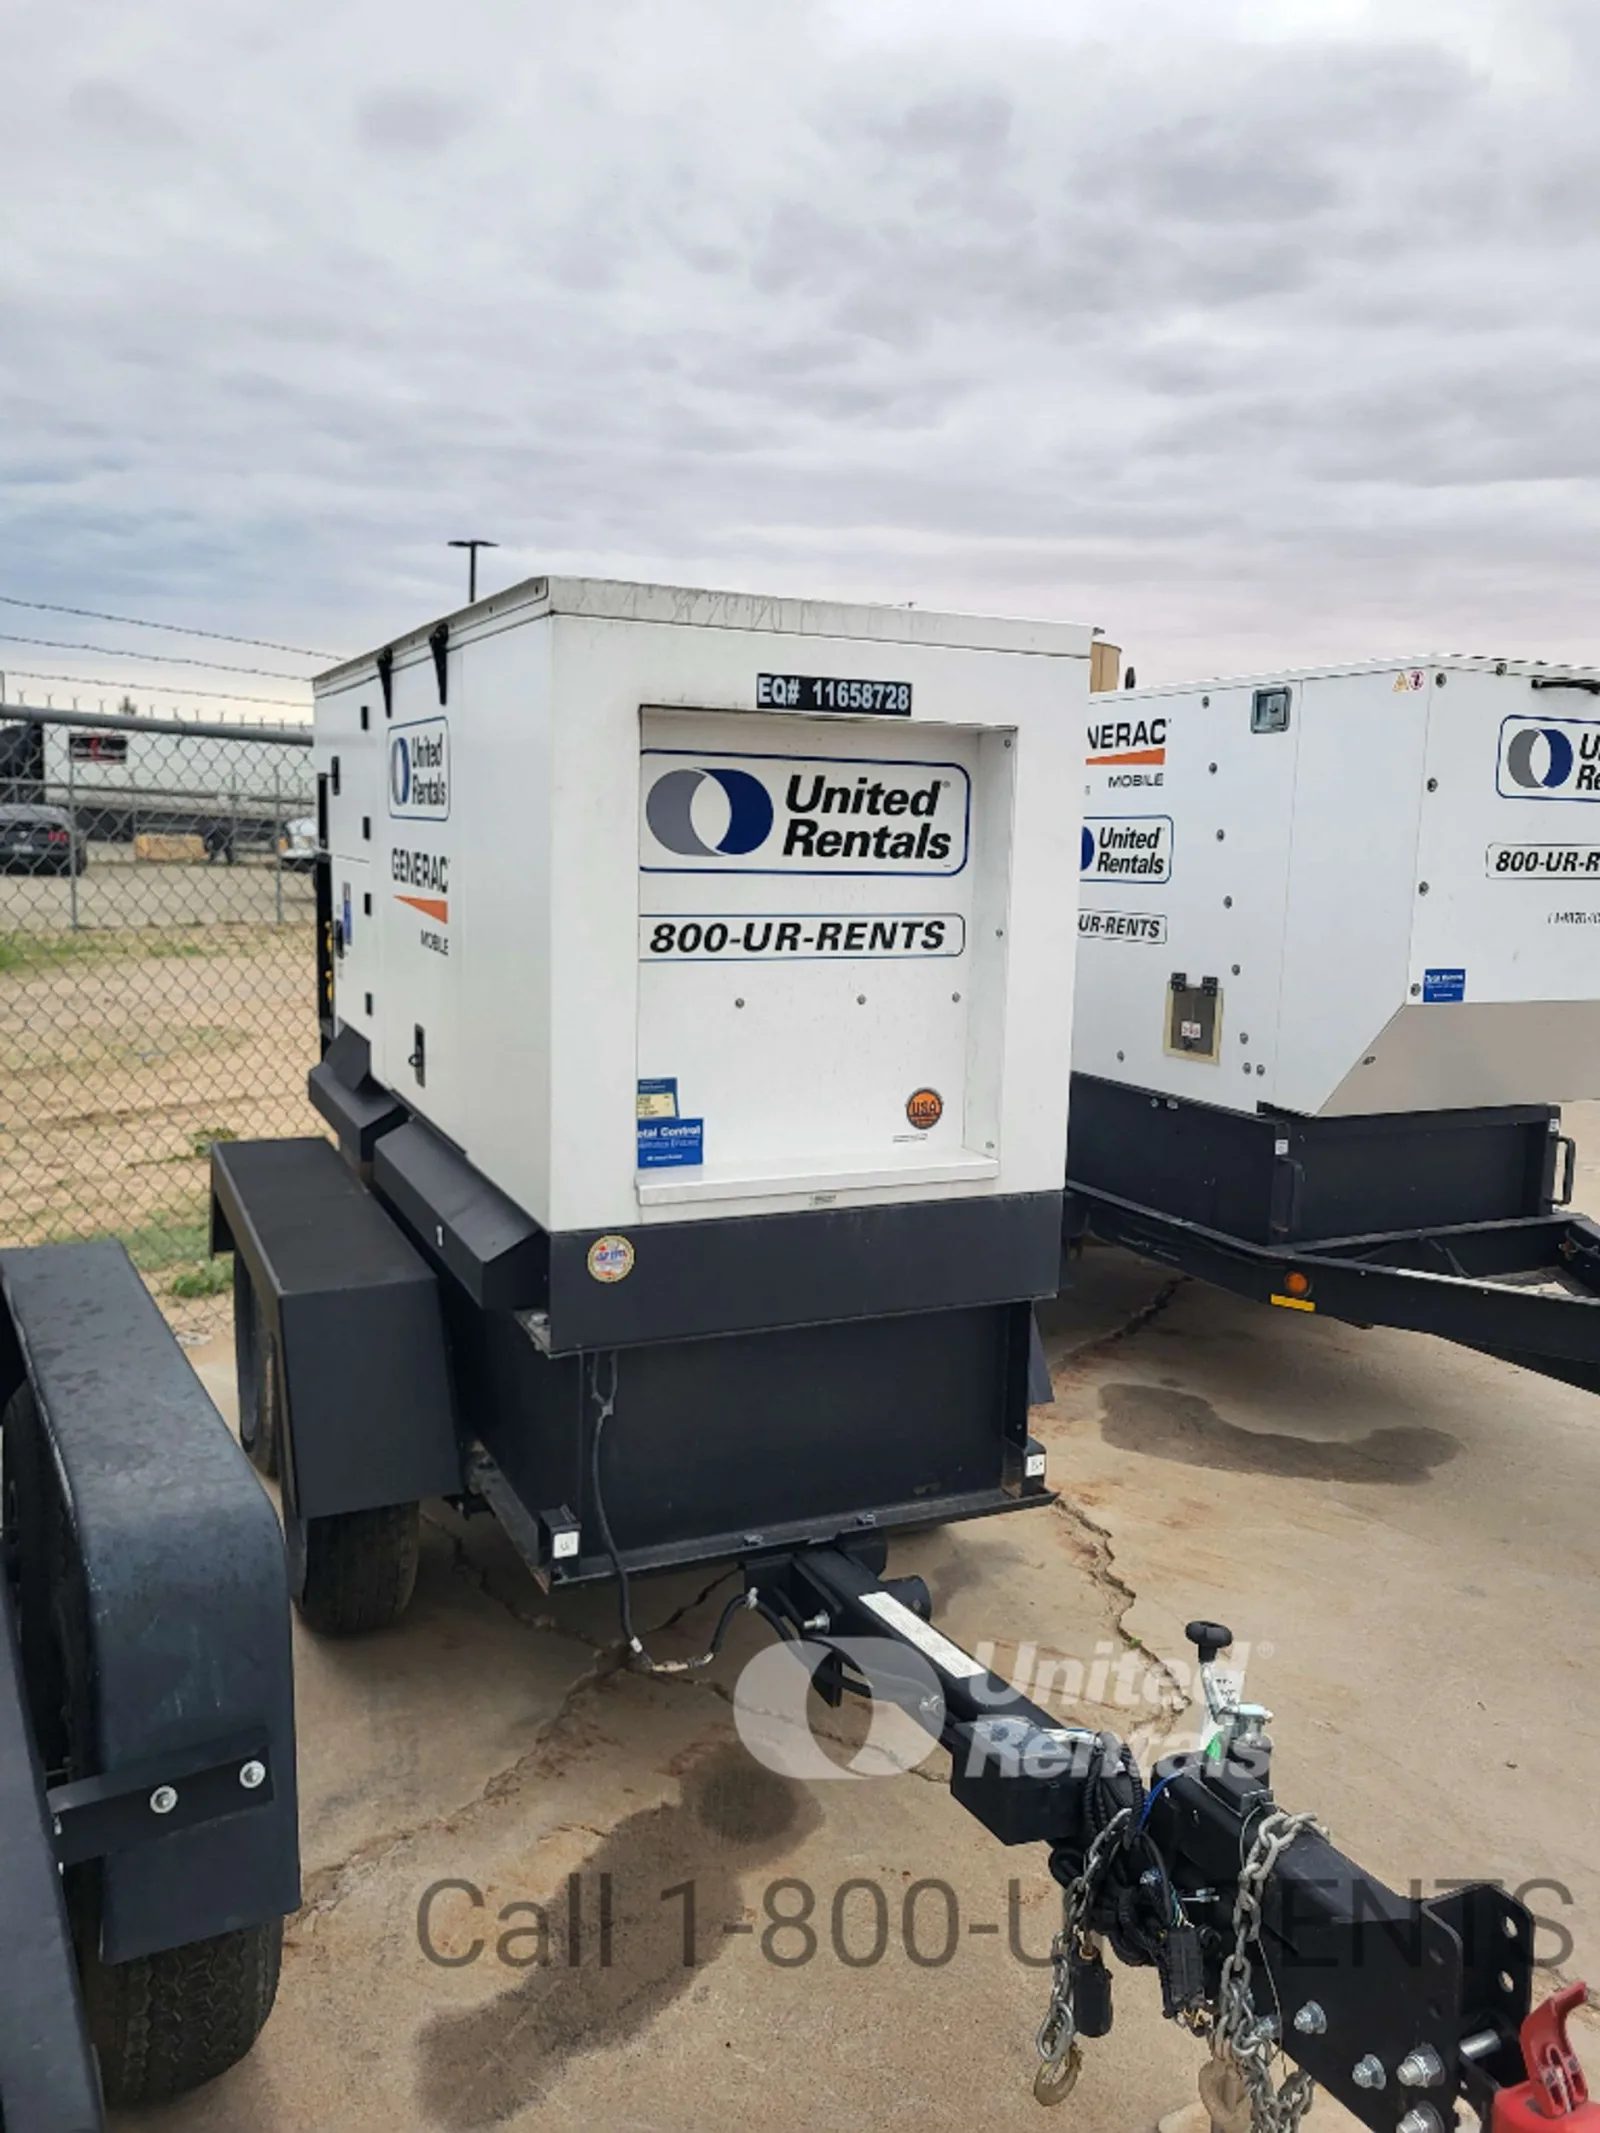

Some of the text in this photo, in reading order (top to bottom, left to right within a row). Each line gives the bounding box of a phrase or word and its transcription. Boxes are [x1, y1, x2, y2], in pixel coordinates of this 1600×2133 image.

[758, 677, 909, 711] EQ# 11658728
[412, 732, 443, 767] United
[412, 772, 447, 806] Rentals
[785, 774, 942, 816] United
[1108, 772, 1164, 788] MOBILE
[782, 818, 951, 859] Rentals
[1098, 826, 1161, 849] United
[391, 848, 448, 894] GENERAC
[1096, 851, 1165, 874] Rentals
[420, 928, 449, 956] MOBILE
[649, 920, 947, 953] 800-UR-RENTS
